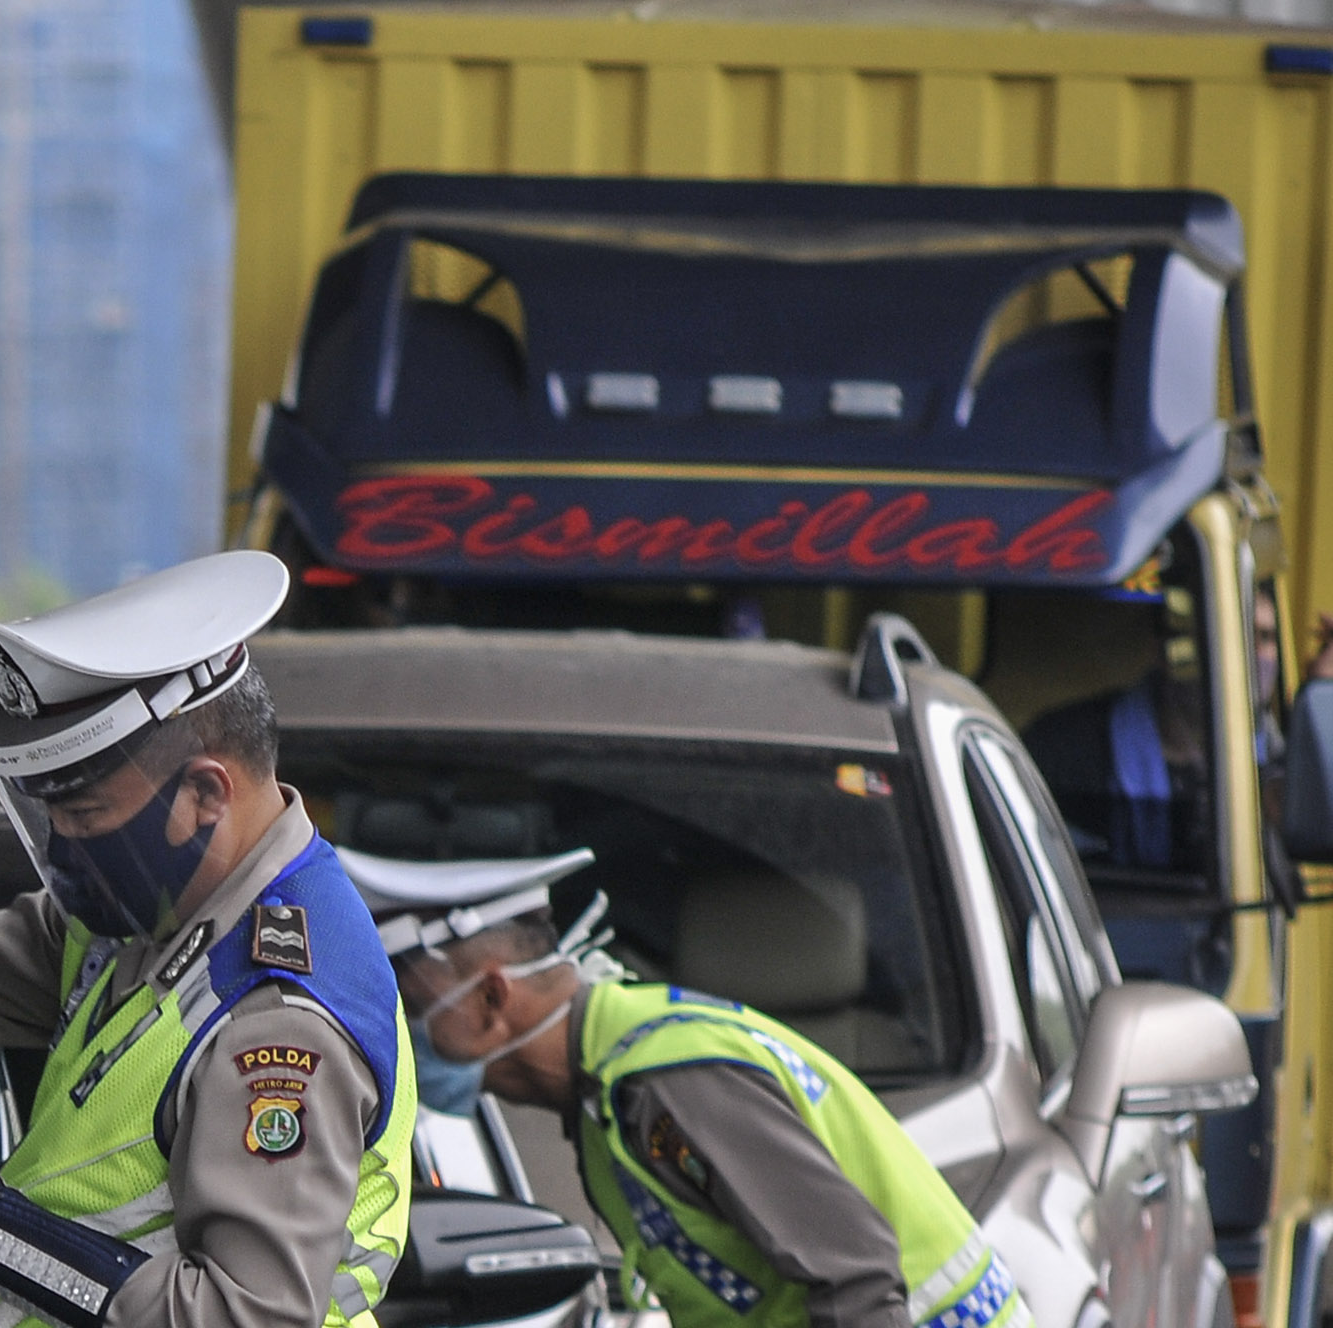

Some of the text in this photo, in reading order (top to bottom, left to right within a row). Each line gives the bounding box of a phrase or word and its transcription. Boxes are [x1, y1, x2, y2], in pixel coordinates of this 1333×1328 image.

[336, 475, 1116, 571] Bismillah
[243, 1047, 312, 1071] POLDA
[253, 1080, 283, 1090] METRO
